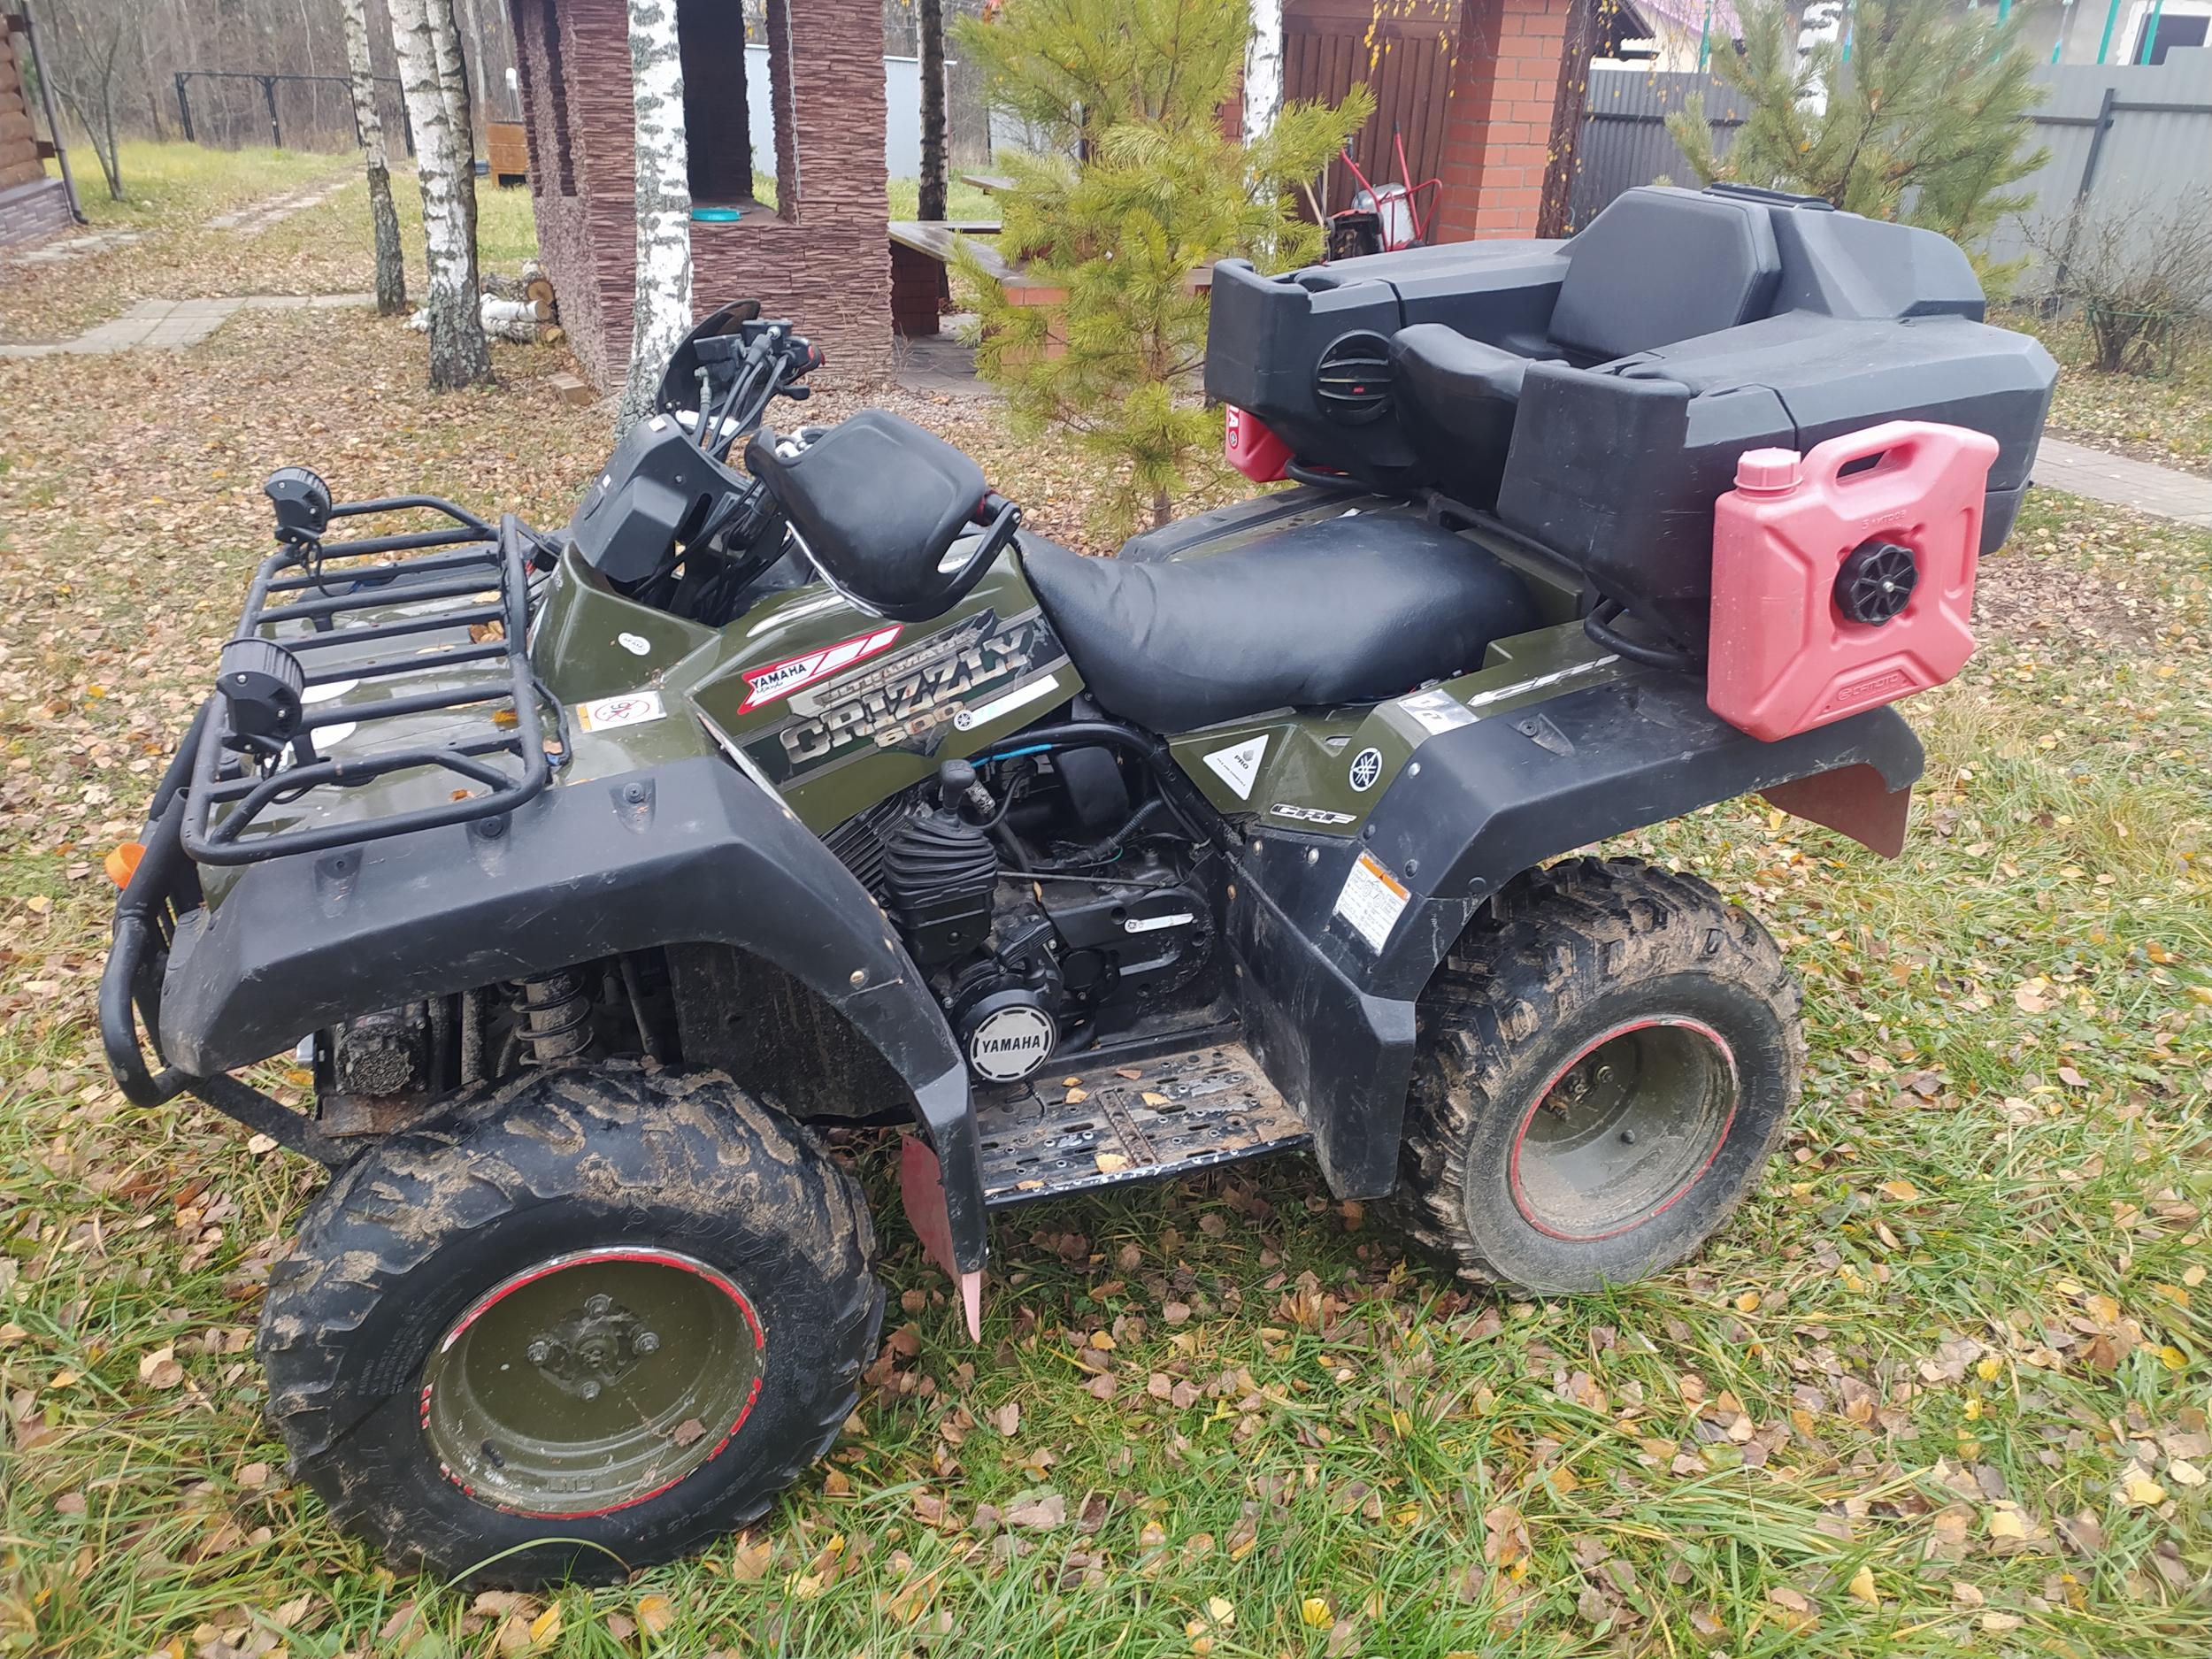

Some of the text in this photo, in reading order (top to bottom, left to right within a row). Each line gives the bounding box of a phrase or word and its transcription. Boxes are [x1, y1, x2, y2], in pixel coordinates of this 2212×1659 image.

[751, 664, 807, 689] YAMAHA
[779, 626, 1033, 764] GRIZZLY
[874, 701, 966, 749] 600
[1233, 755, 1249, 770] PRO
[1271, 803, 1357, 824] CRF
[982, 1035, 1041, 1053] YAMAHA
